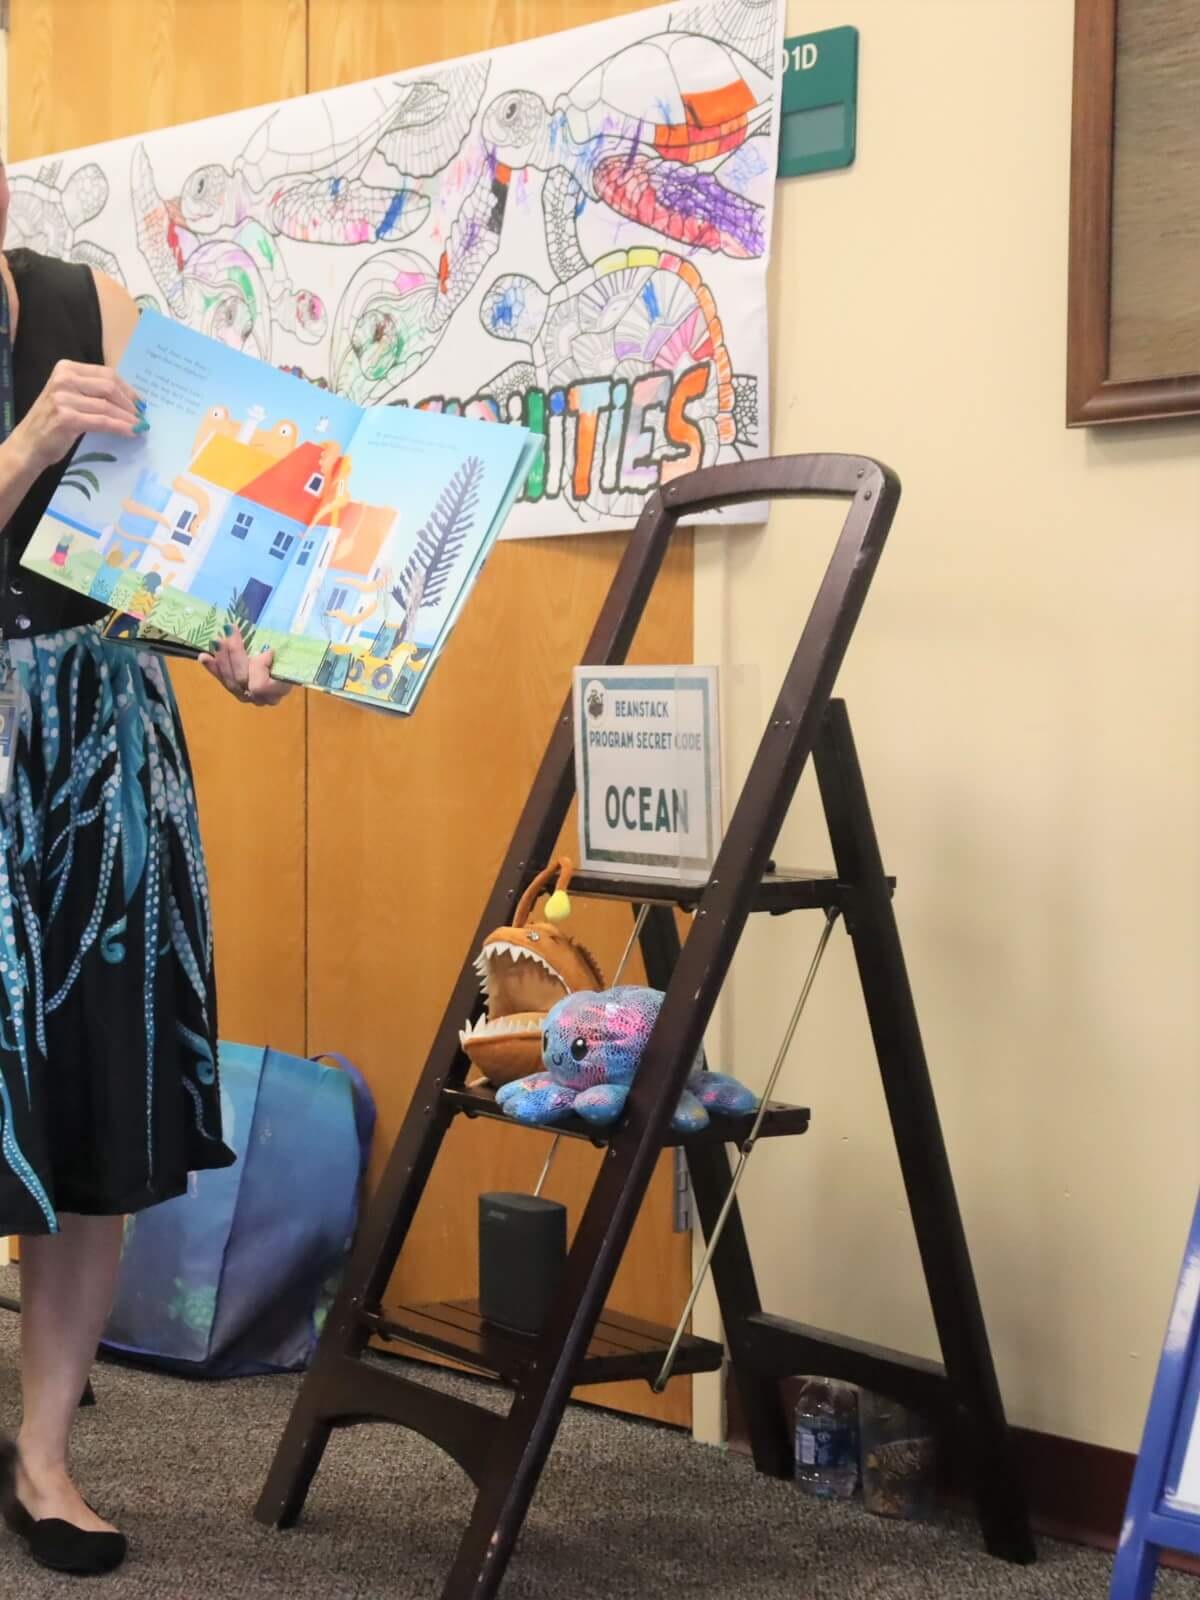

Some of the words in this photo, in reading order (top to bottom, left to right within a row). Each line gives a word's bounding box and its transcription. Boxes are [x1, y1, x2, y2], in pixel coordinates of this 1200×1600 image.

[615, 700, 669, 718] BEANSTACK
[589, 731, 634, 749] PROGRAM
[636, 732, 672, 750] SECRET
[674, 733, 701, 751] CODE
[605, 785, 689, 834] OCEAN
